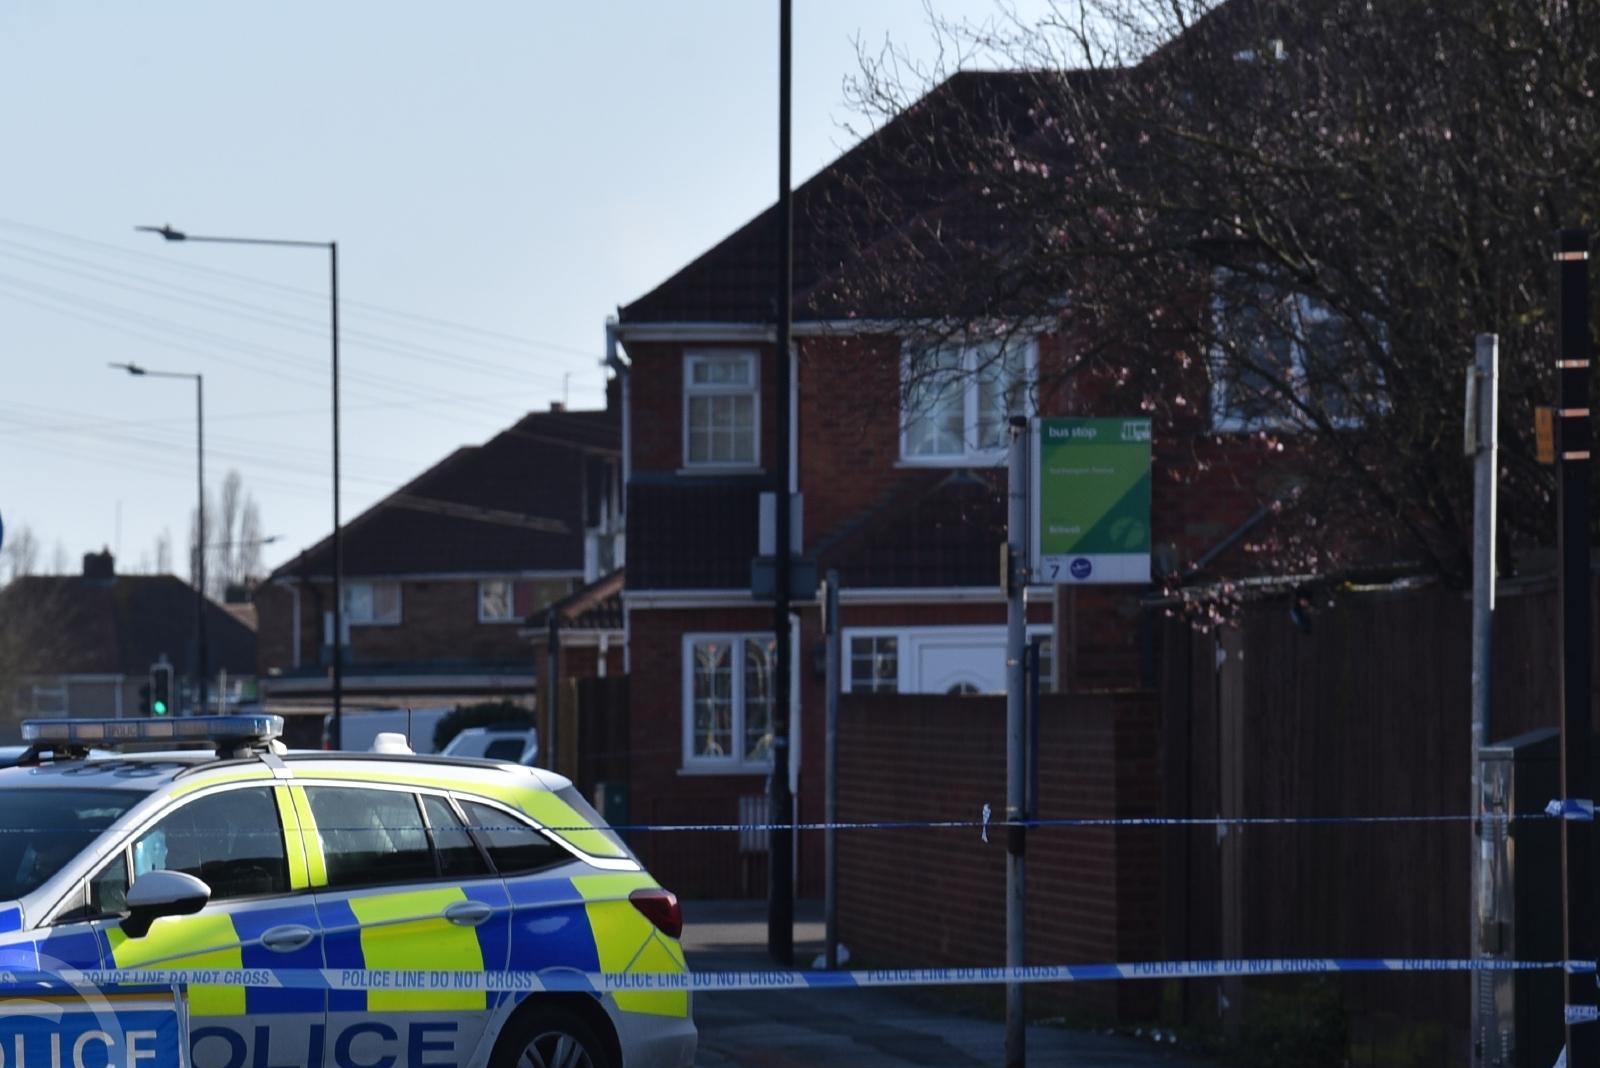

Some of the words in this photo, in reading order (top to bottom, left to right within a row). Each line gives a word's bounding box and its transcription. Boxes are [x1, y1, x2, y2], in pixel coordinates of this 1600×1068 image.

[1049, 427, 1068, 437] bus
[1071, 427, 1097, 438] stop
[1051, 565, 1060, 579] 7
[82, 971, 129, 984] POLICE
[134, 971, 164, 984] LINE
[169, 971, 188, 984] DO
[192, 972, 219, 984] NOT
[224, 972, 269, 984] CROSS
[342, 971, 390, 987] POLICE
[395, 972, 425, 987] LINE
[430, 972, 449, 988] DO
[454, 972, 481, 988] NOT
[486, 972, 532, 988] CROSS
[605, 972, 653, 987] POLICE
[658, 973, 688, 987] LINE
[693, 973, 712, 986] DO
[717, 973, 744, 985] NOT
[749, 972, 794, 985] CROSS
